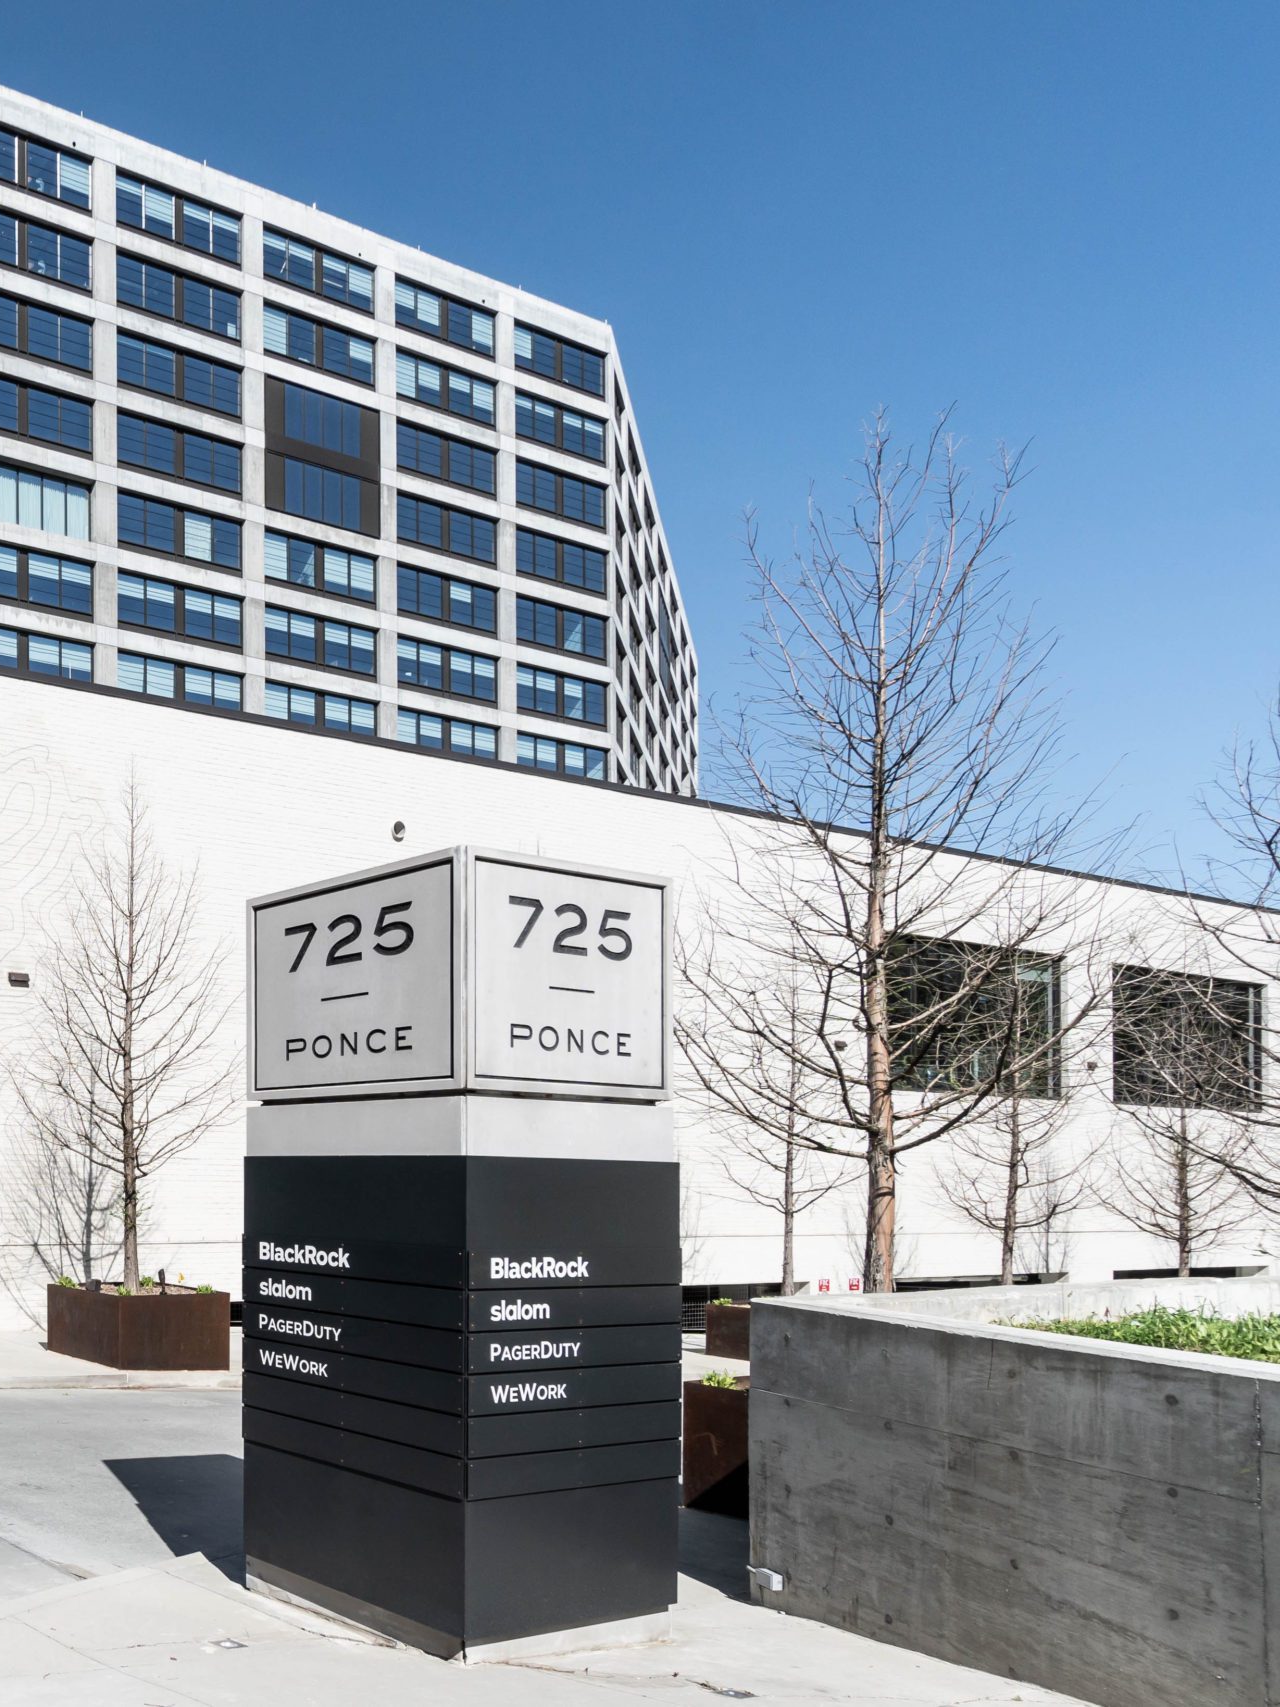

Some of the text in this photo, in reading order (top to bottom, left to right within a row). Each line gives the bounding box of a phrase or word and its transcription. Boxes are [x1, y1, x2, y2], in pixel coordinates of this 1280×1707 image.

[284, 900, 415, 974] 725
[508, 894, 633, 962] 725
[285, 1025, 413, 1062] PONCE
[509, 1022, 632, 1058] PONCE
[258, 1241, 351, 1269] BlackRock
[489, 1256, 590, 1280] BlackRock
[259, 1277, 313, 1302] slalom
[489, 1298, 551, 1322] slalom
